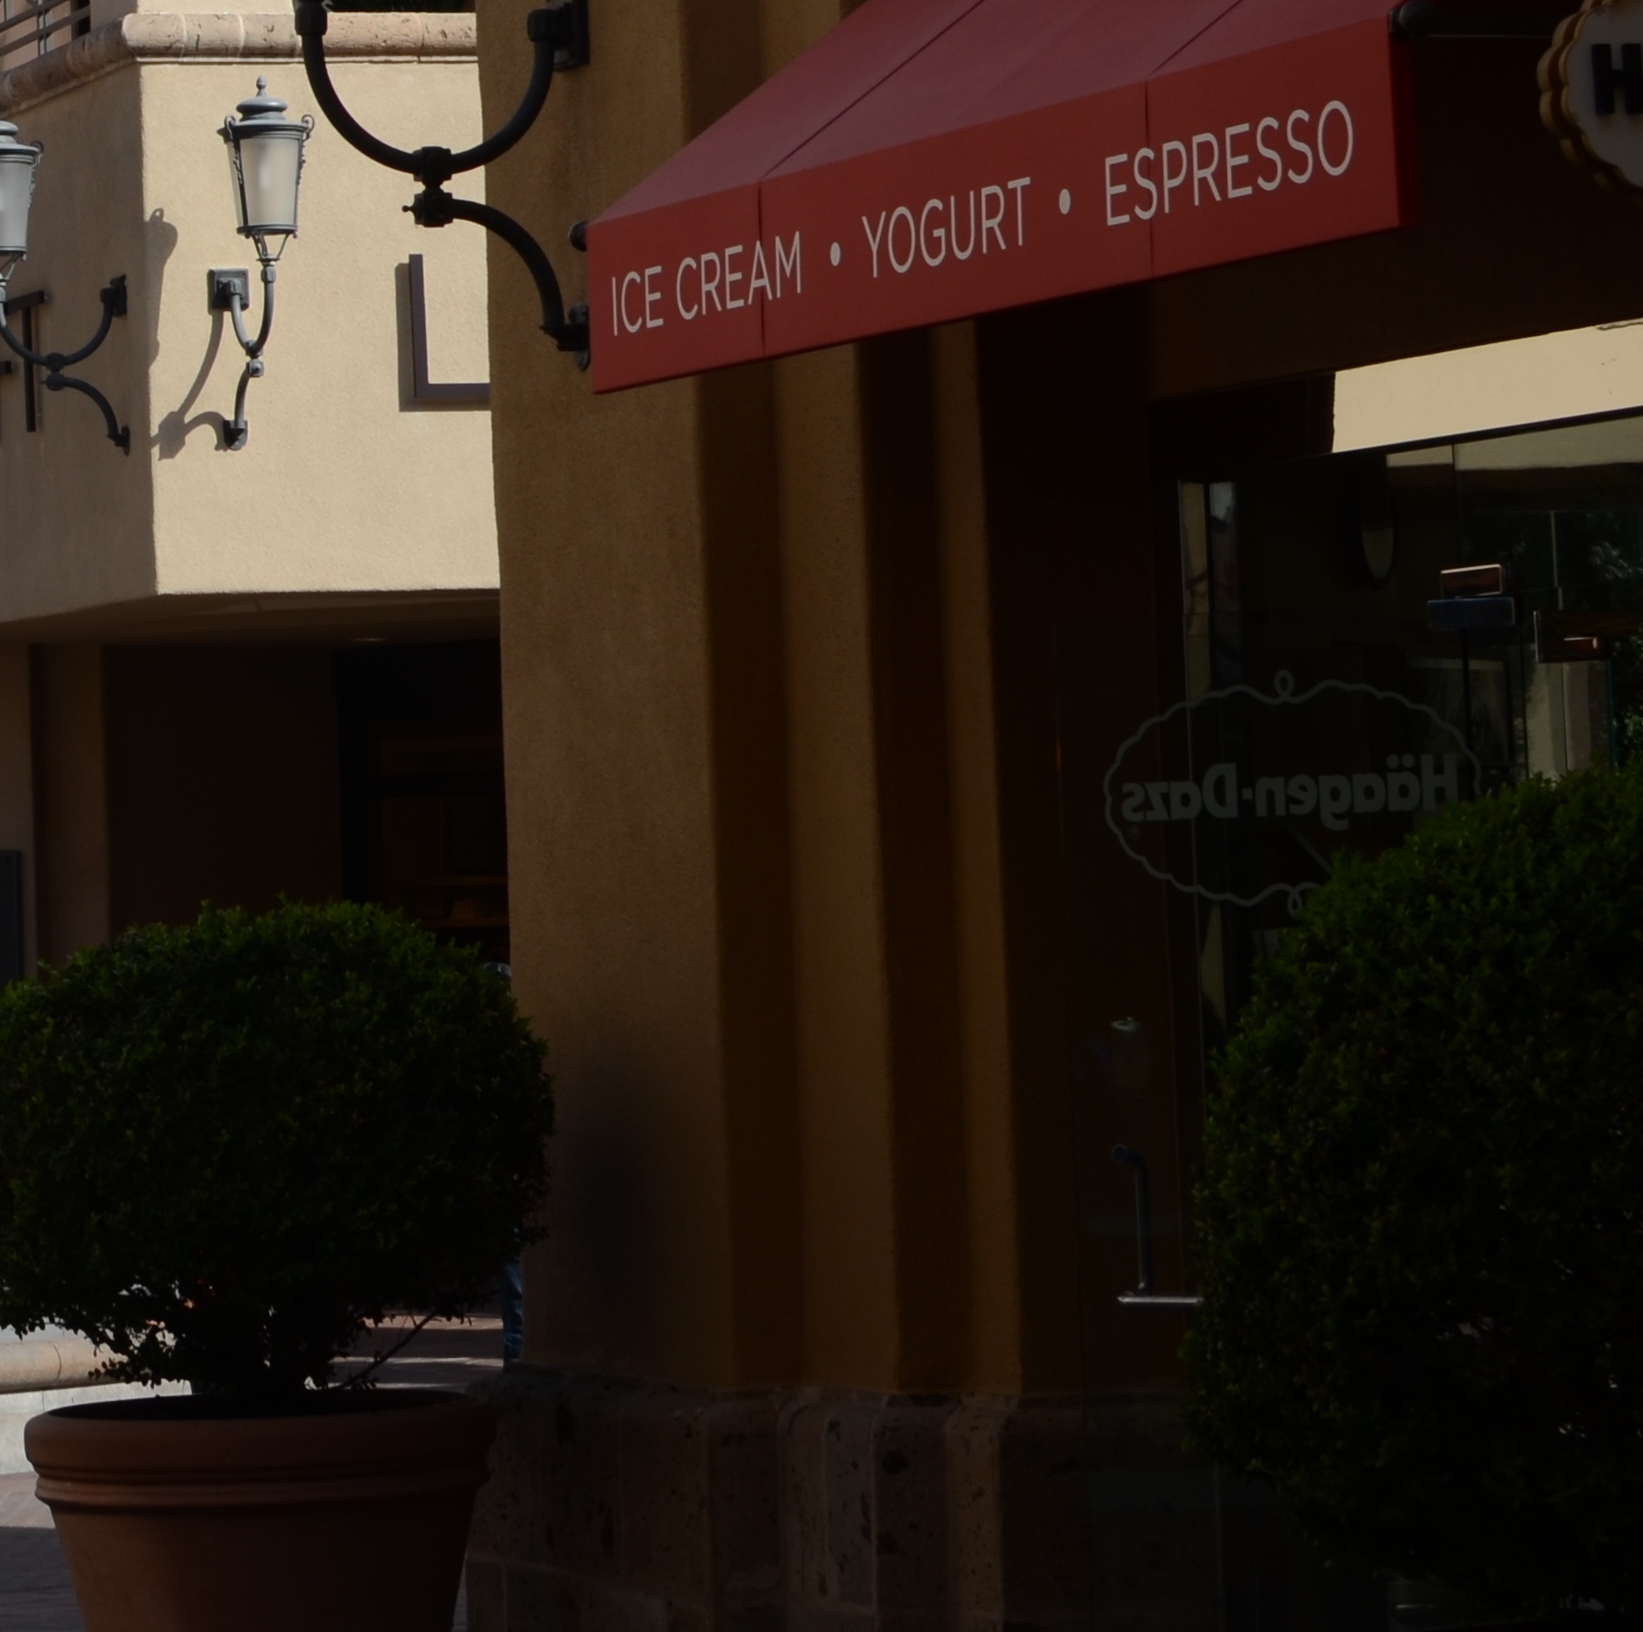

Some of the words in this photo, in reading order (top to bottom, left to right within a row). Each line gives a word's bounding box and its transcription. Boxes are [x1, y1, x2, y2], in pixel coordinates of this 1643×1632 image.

[610, 264, 663, 335] ICE
[675, 230, 802, 322] CREAM
[861, 176, 1032, 278] YOGURT
[1104, 98, 1355, 227] ESPRESSO
